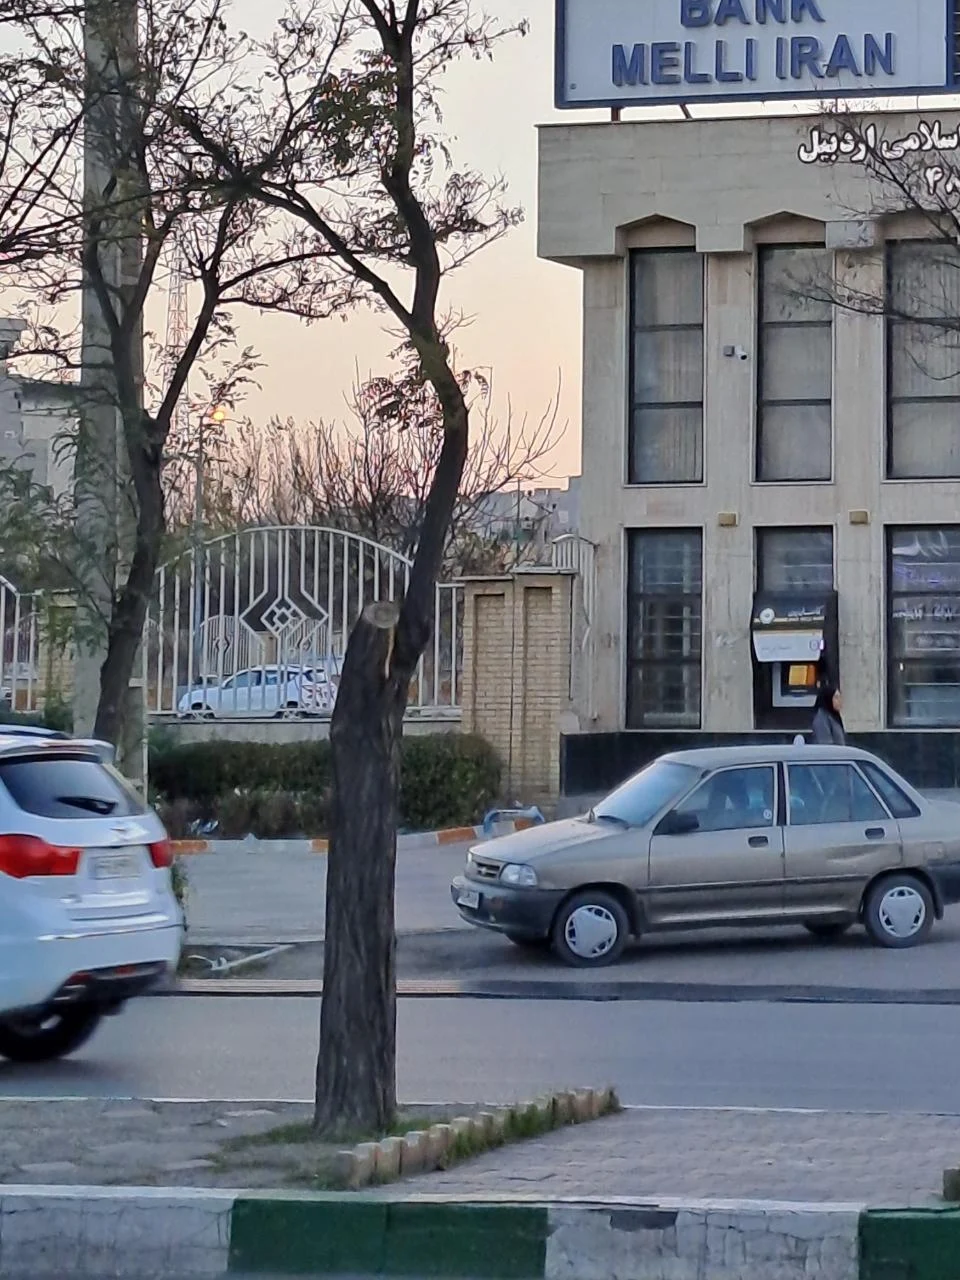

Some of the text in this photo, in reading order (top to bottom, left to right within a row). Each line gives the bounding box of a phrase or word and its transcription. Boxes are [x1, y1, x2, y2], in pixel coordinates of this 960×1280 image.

[611, 32, 895, 86] MELLI IRAN
[798, 124, 877, 163] اردبیل
